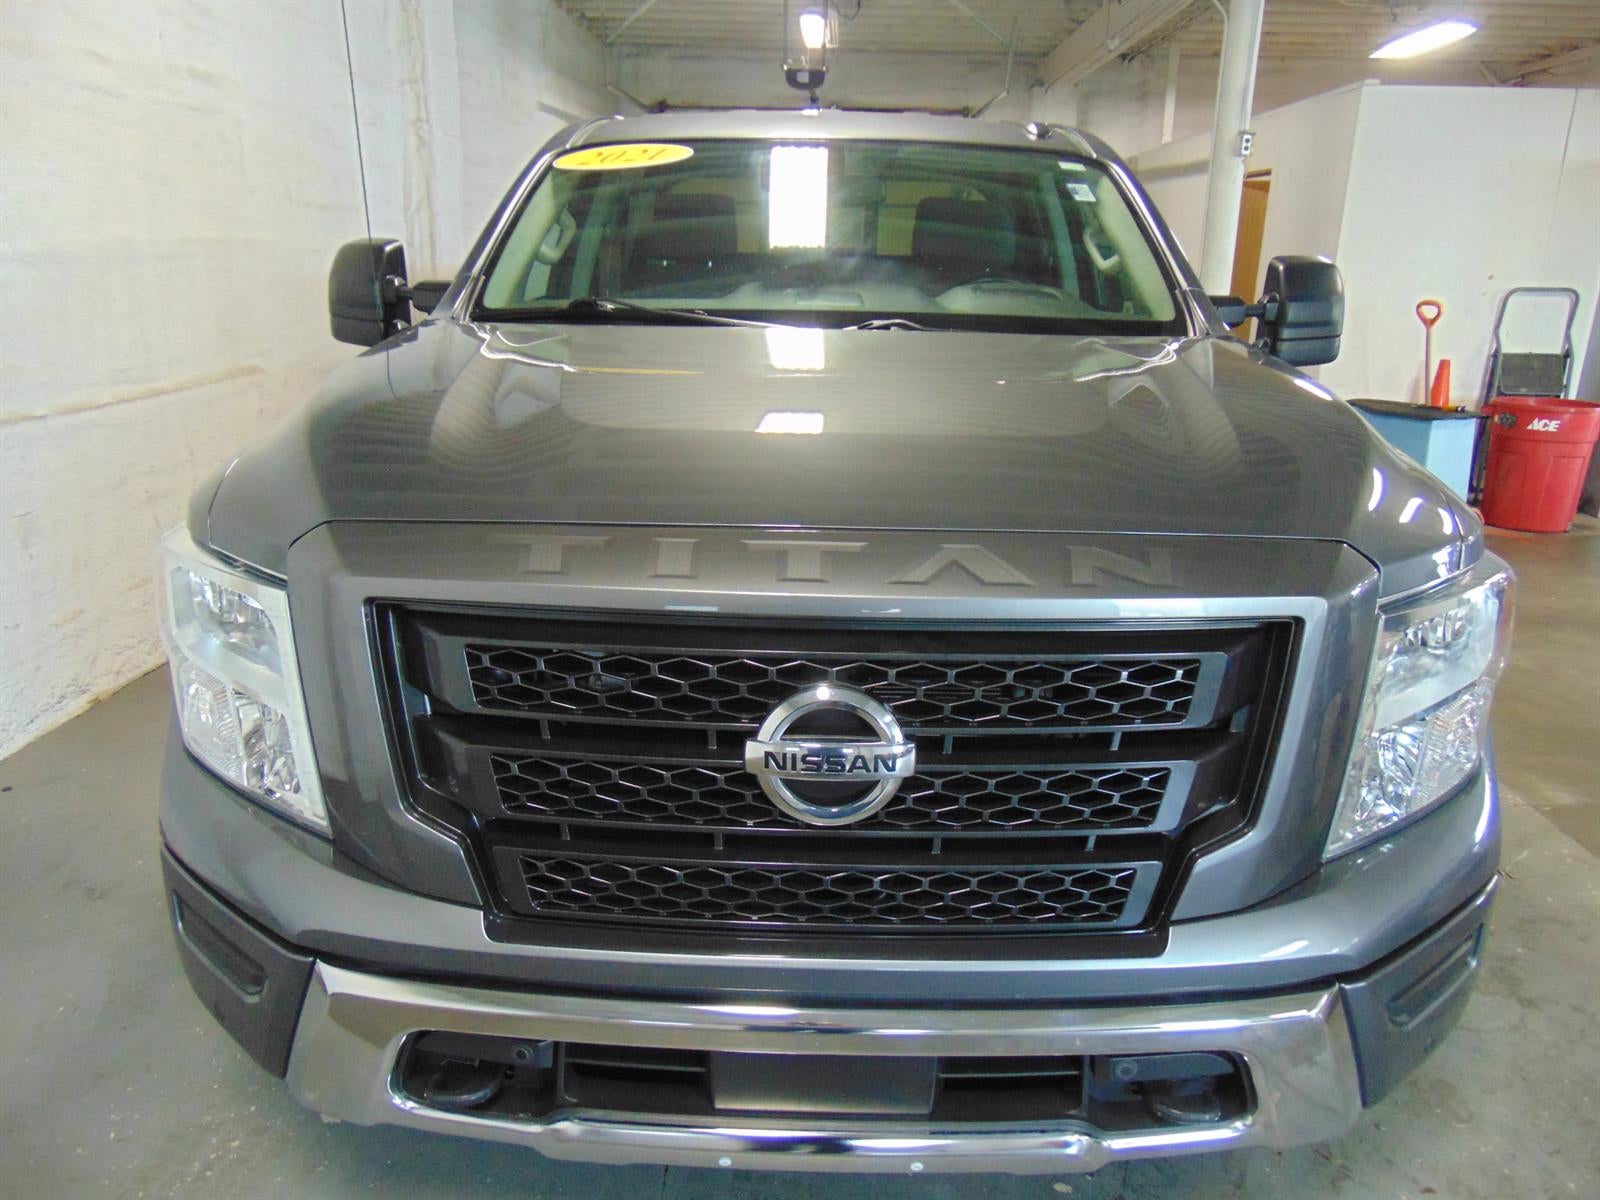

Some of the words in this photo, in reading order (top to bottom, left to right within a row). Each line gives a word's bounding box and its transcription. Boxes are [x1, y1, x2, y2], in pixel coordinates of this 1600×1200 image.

[1526, 417, 1561, 432] ACE
[498, 534, 1182, 588] TITAN
[763, 751, 898, 773] NISSAN
